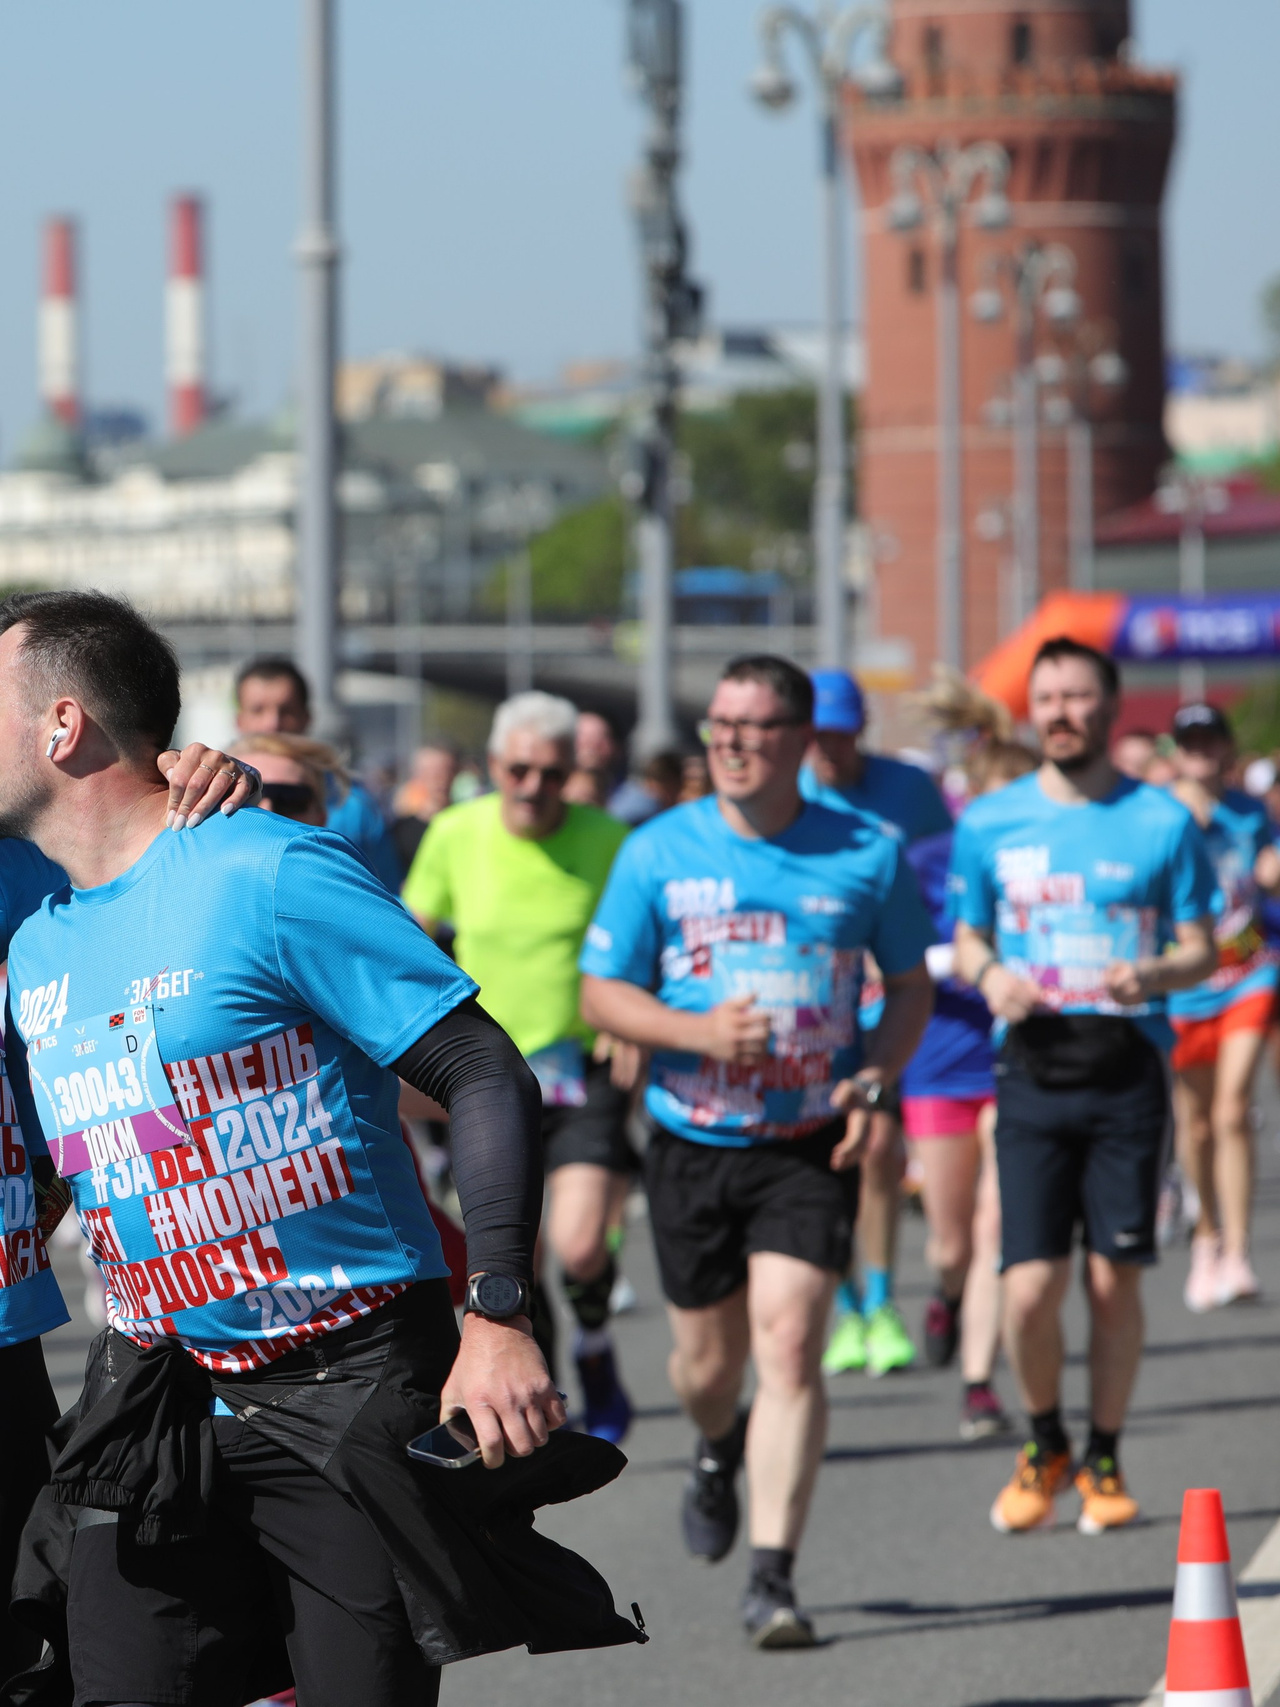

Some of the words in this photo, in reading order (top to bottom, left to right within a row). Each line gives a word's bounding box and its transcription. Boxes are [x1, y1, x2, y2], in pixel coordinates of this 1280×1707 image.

[18, 973, 69, 1040] 2024
[134, 1009, 145, 1017] FON
[134, 1015, 146, 1023] BET
[42, 1035, 58, 1050] ПСБ
[125, 1034, 138, 1053] D
[170, 1030, 320, 1118] #ЦЕЛЬ
[53, 1057, 143, 1126] 30043
[90, 1119, 217, 1205] #ЗАБЕГ
[217, 1081, 333, 1172] 2024
[149, 1142, 355, 1250] #МОМЕНТ
[245, 1264, 352, 1339] 2024
